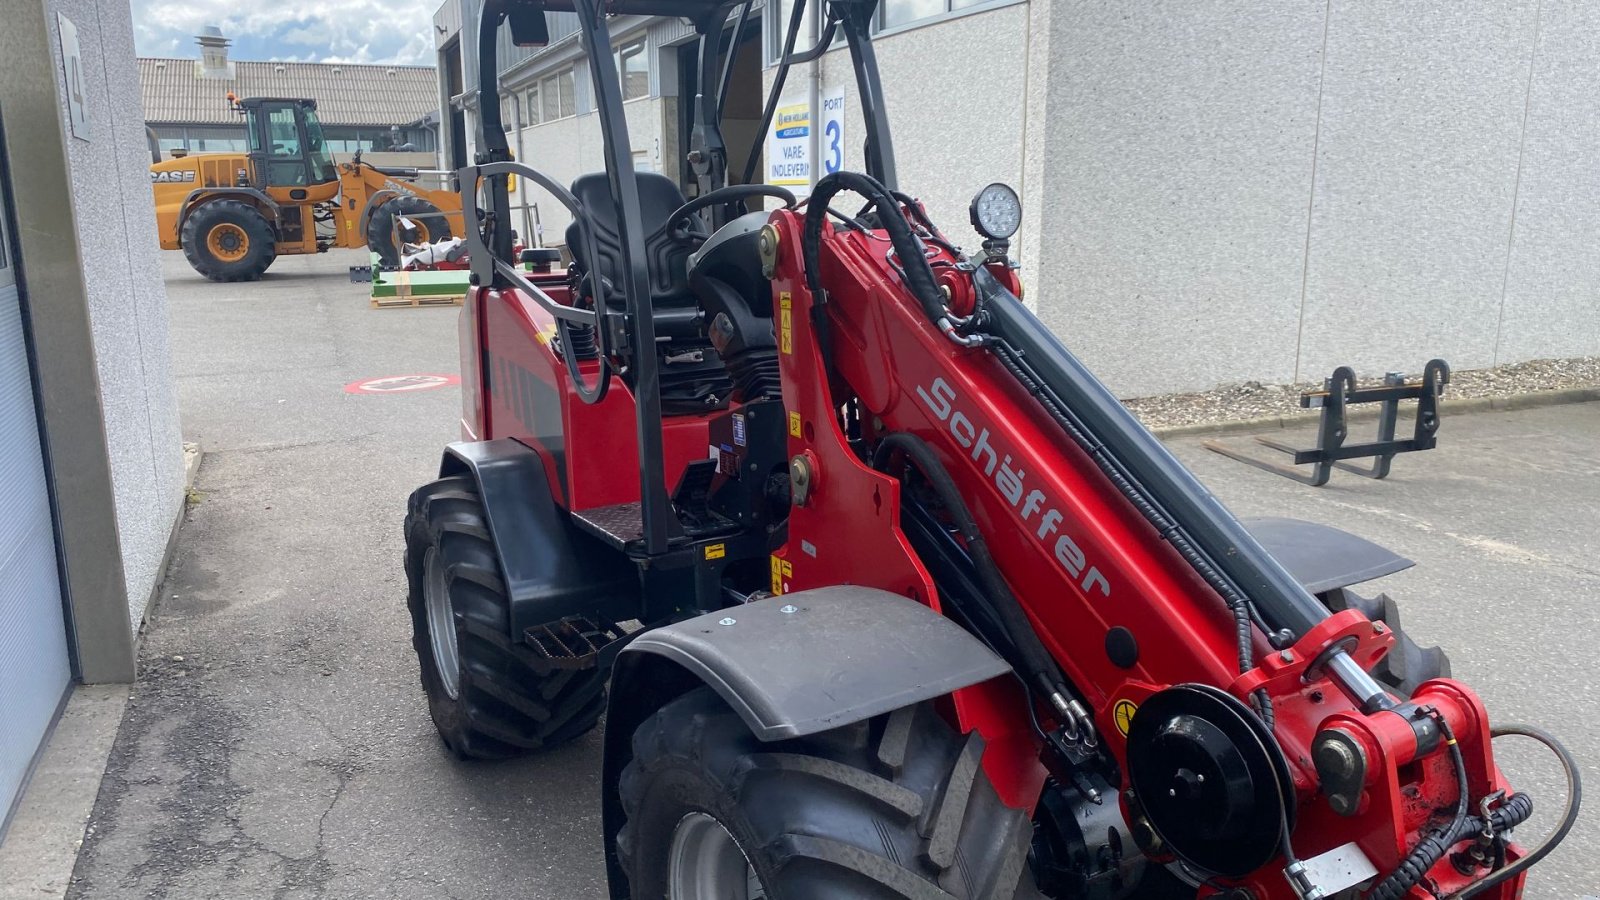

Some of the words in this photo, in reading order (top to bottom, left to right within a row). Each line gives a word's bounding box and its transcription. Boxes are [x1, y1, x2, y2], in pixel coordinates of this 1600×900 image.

[824, 97, 843, 111] PORT
[783, 146, 805, 159] VARE-
[825, 119, 841, 173] 3
[150, 171, 195, 184] CASE
[916, 377, 1111, 597] Schäffer
